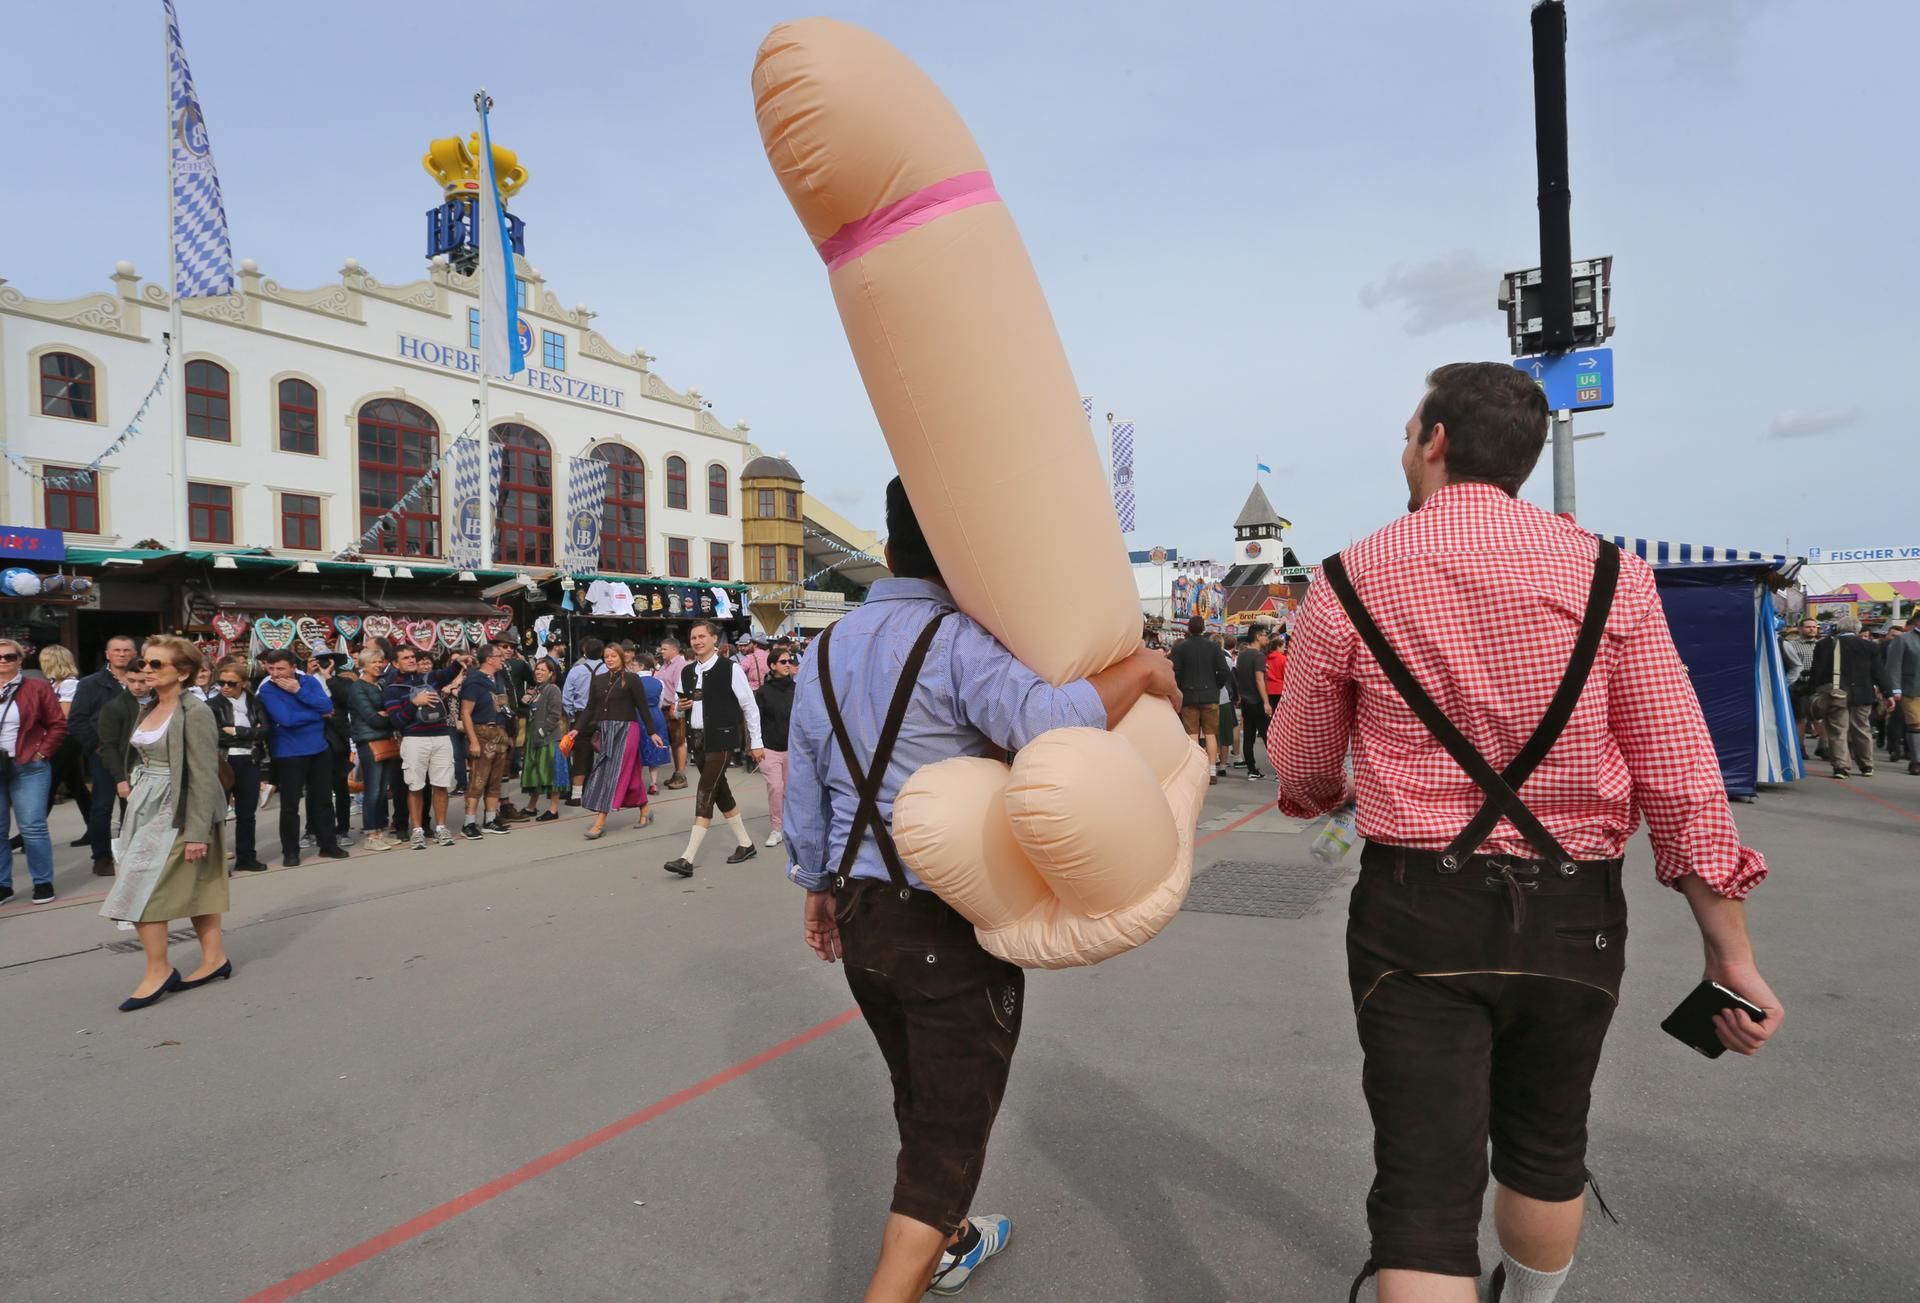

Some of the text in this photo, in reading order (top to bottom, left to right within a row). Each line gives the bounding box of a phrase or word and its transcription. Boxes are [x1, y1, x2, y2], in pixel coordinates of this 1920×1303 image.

[1580, 375, 1597, 385] U4
[527, 367, 624, 408] FESTZELT
[1581, 390, 1598, 400] U5
[576, 529, 591, 546] HB
[1831, 549, 1894, 561] FISCHER
